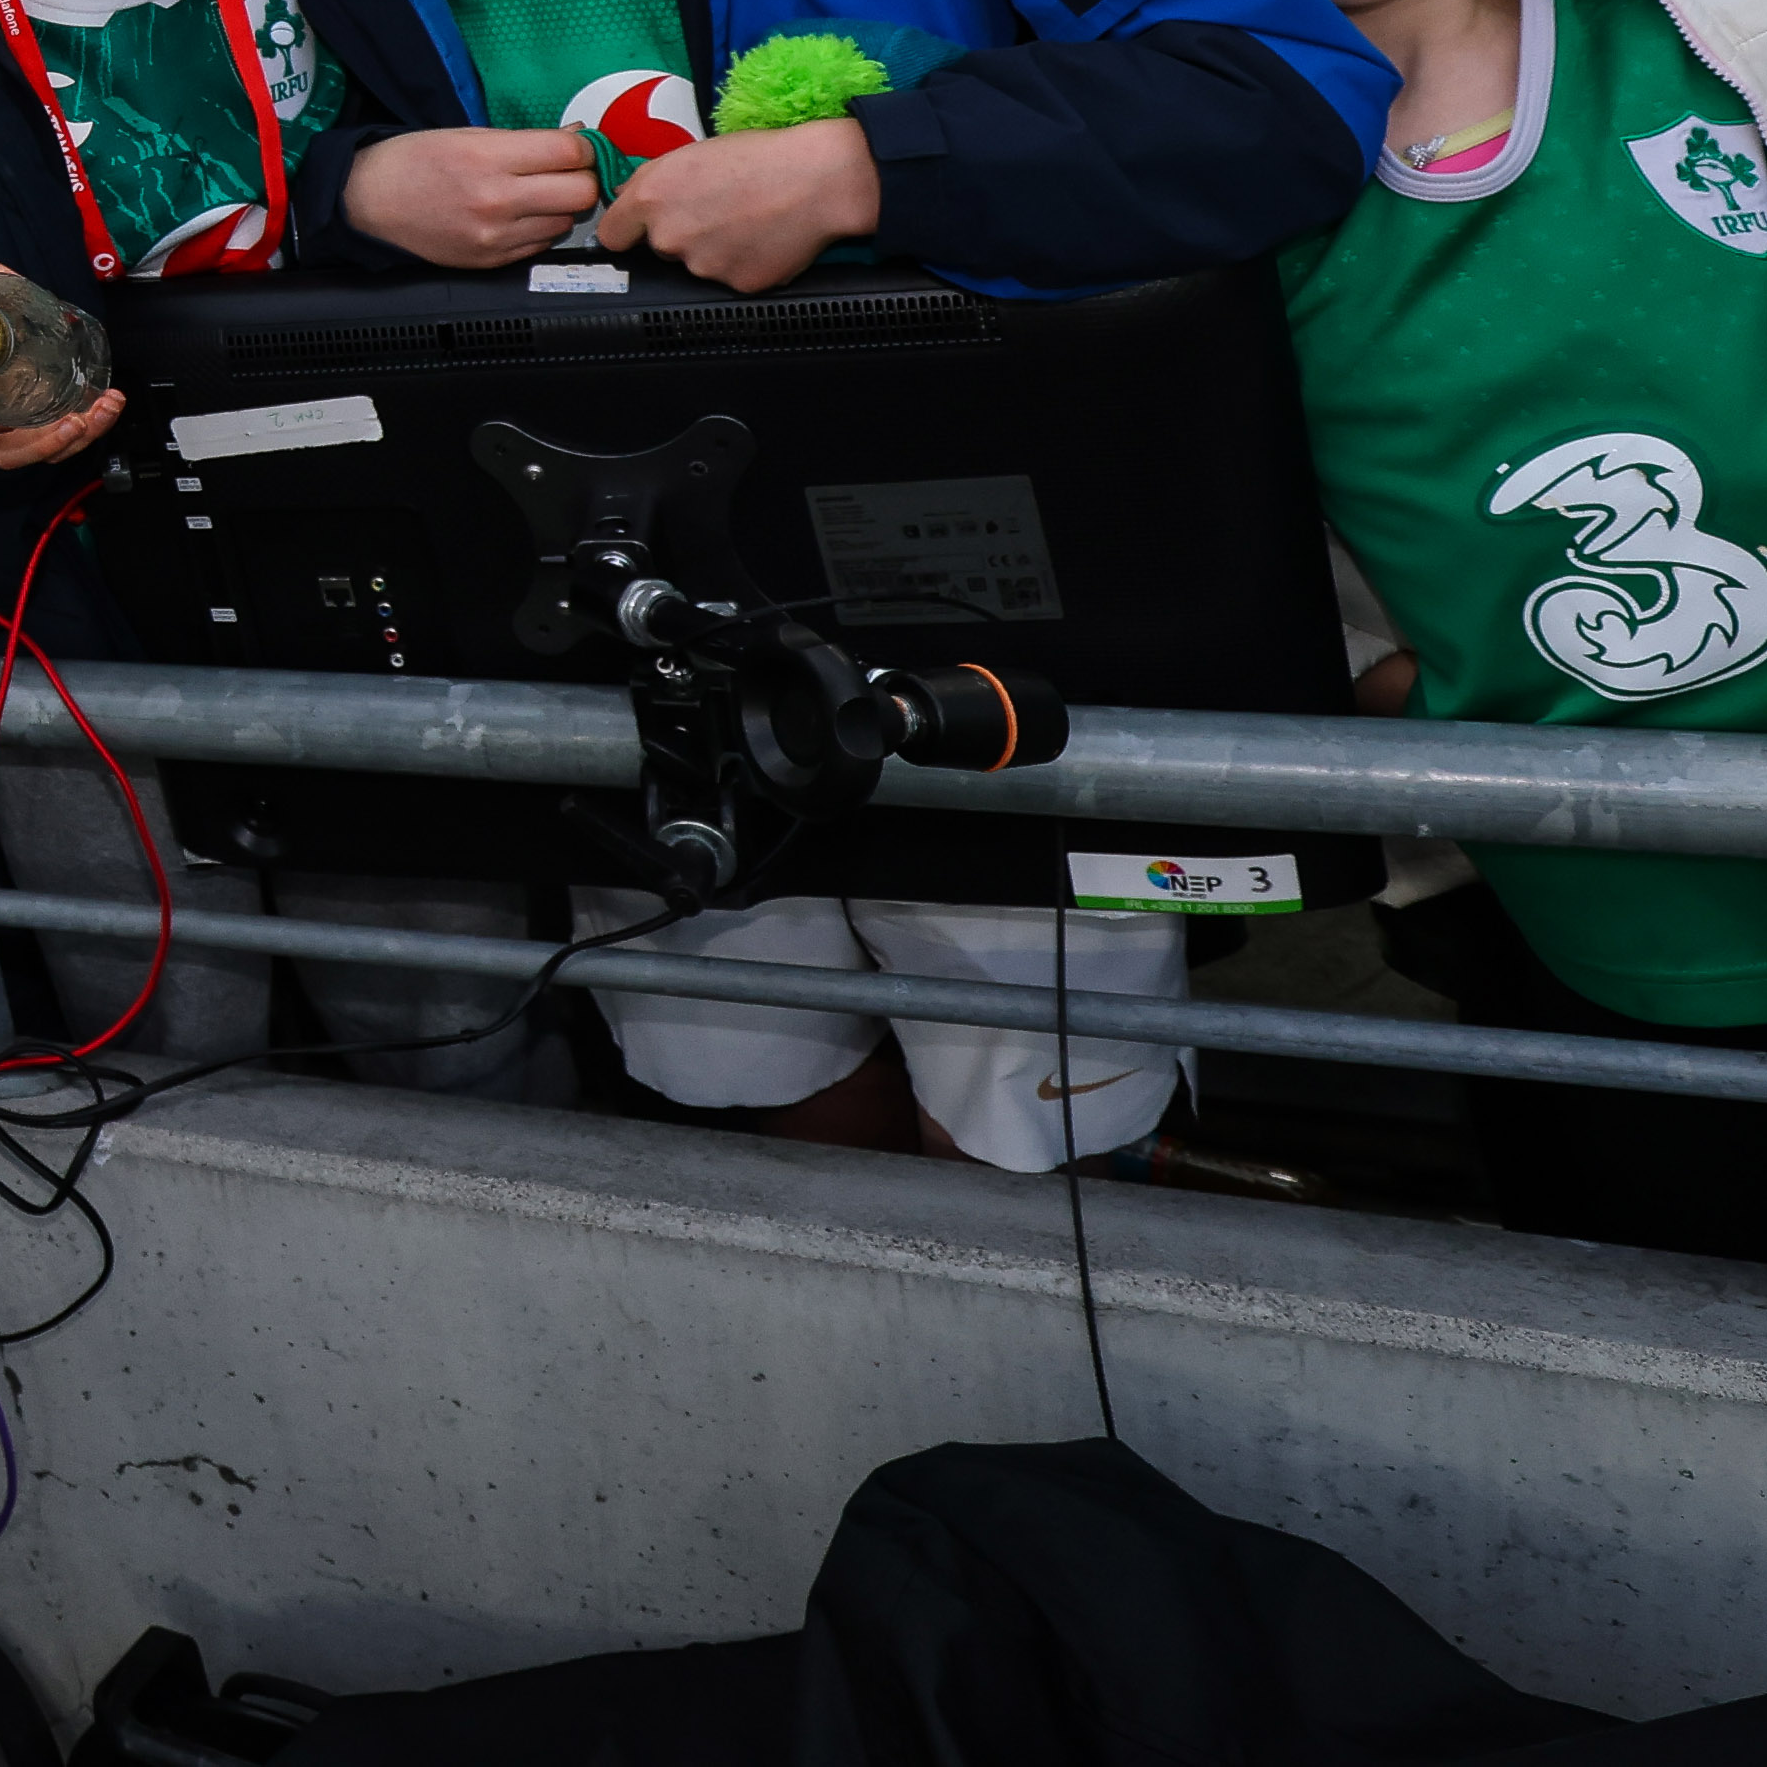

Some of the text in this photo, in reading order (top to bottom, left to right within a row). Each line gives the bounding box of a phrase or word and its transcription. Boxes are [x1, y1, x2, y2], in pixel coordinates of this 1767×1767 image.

[270, 70, 309, 103] IRFU
[1711, 211, 1767, 236] IRFU
[1170, 866, 1273, 893] NEP 3
